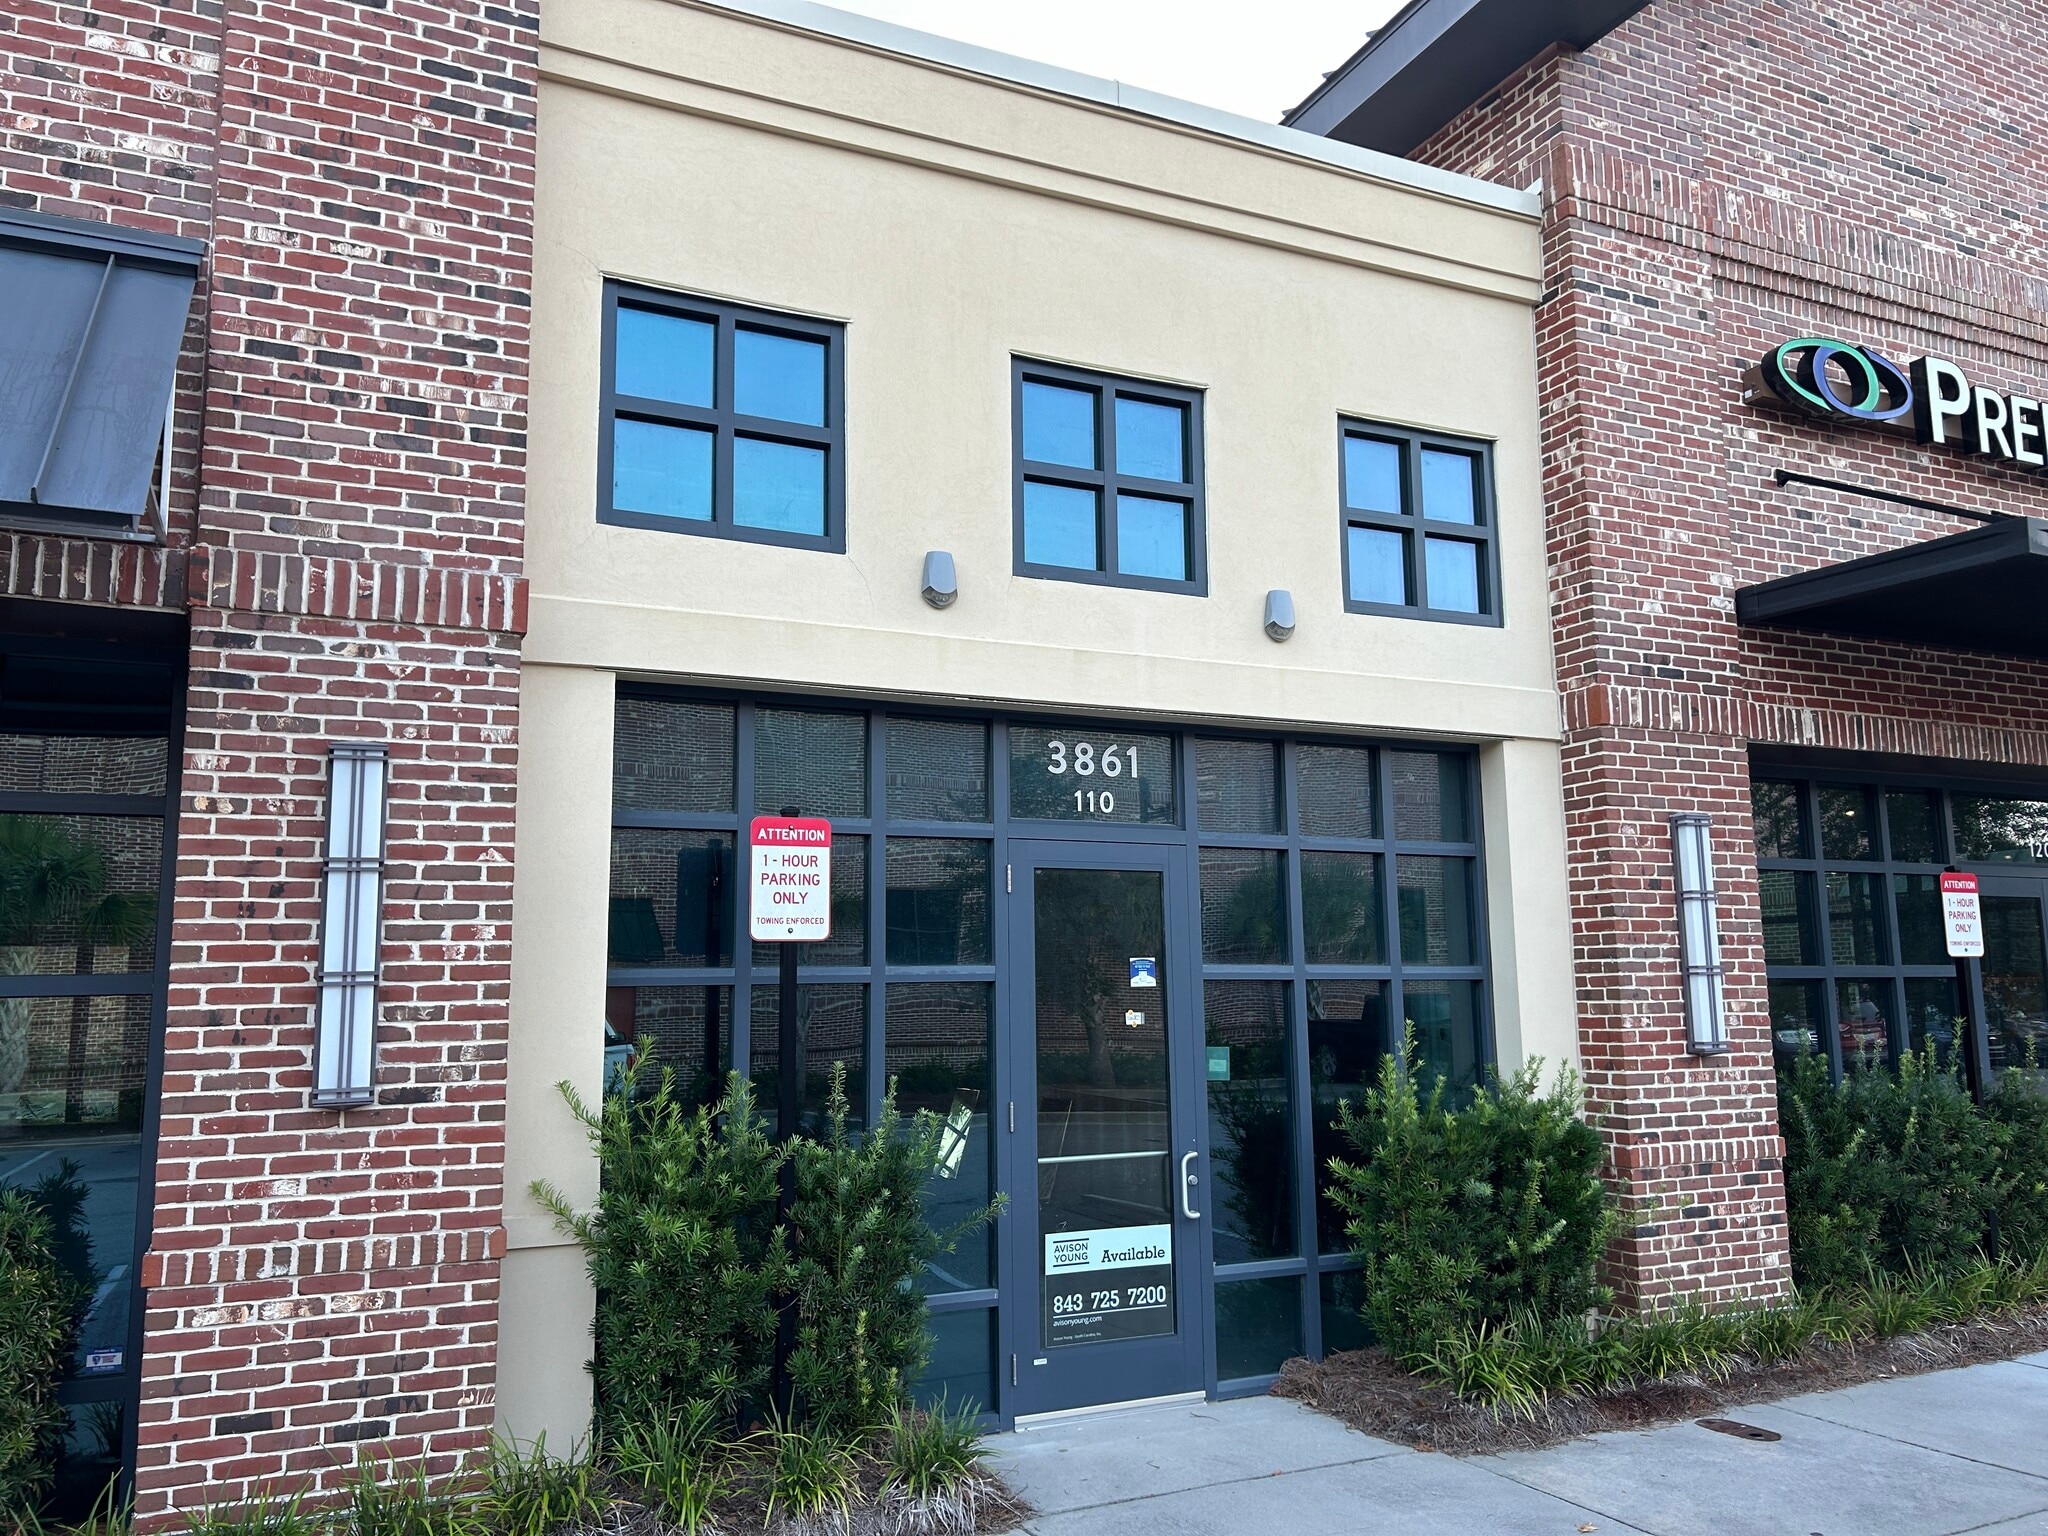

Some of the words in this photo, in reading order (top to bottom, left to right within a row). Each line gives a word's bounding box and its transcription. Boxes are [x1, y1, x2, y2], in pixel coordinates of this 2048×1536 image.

[1925, 355, 2048, 466] PRE
[1047, 740, 1138, 778] 3861
[1074, 790, 1114, 813] 110
[757, 828, 825, 841] ATTENTION
[781, 854, 818, 867] HOUR
[761, 873, 820, 886] PARKING
[1943, 880, 1976, 889] ATTENTION
[773, 892, 808, 904] ONLY
[756, 917, 784, 925] TOWING
[786, 917, 824, 925] ENFORCED
[1948, 911, 1977, 920] PARKING
[1955, 923, 1972, 933] ONLY
[1053, 1242, 1089, 1254] AVISON
[1101, 1245, 1165, 1263] Available
[1053, 1252, 1089, 1263] YOUNG
[1053, 1293, 1083, 1313] 843
[1090, 1289, 1120, 1309] 725
[1127, 1285, 1167, 1305] 7200
[1053, 1316, 1102, 1327] avisonyoung.com
